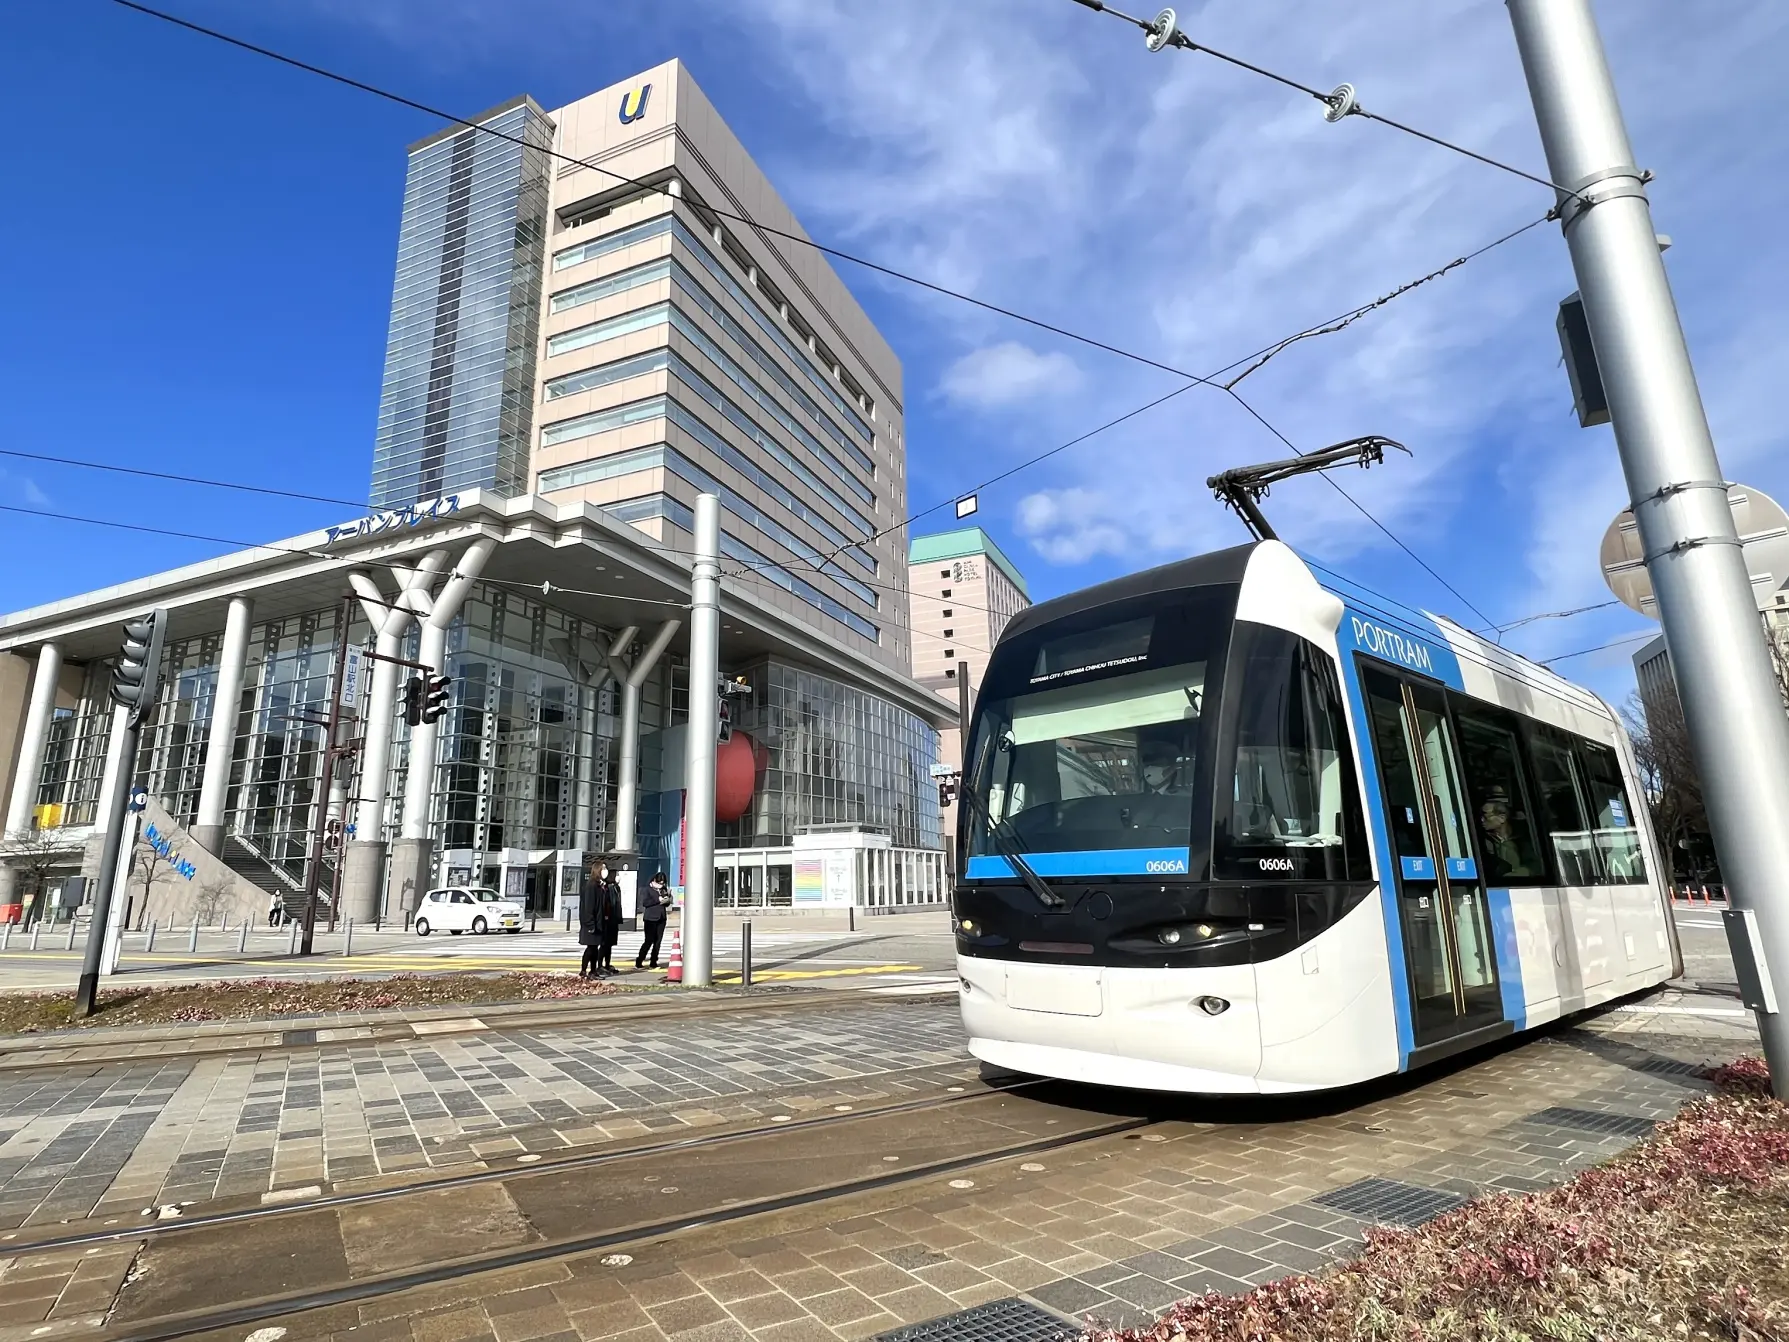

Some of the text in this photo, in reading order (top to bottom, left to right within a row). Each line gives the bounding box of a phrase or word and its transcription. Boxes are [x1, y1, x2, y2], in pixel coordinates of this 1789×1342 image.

[324, 494, 461, 548] アーバンプレイス
[1351, 616, 1433, 673] PORTRAM
[1029, 675, 1049, 684] TOYAMA
[1049, 671, 1061, 680] CITY
[1063, 666, 1085, 677] TOYAMA
[1146, 860, 1185, 872] 0606A
[1259, 858, 1295, 871] 0606A
